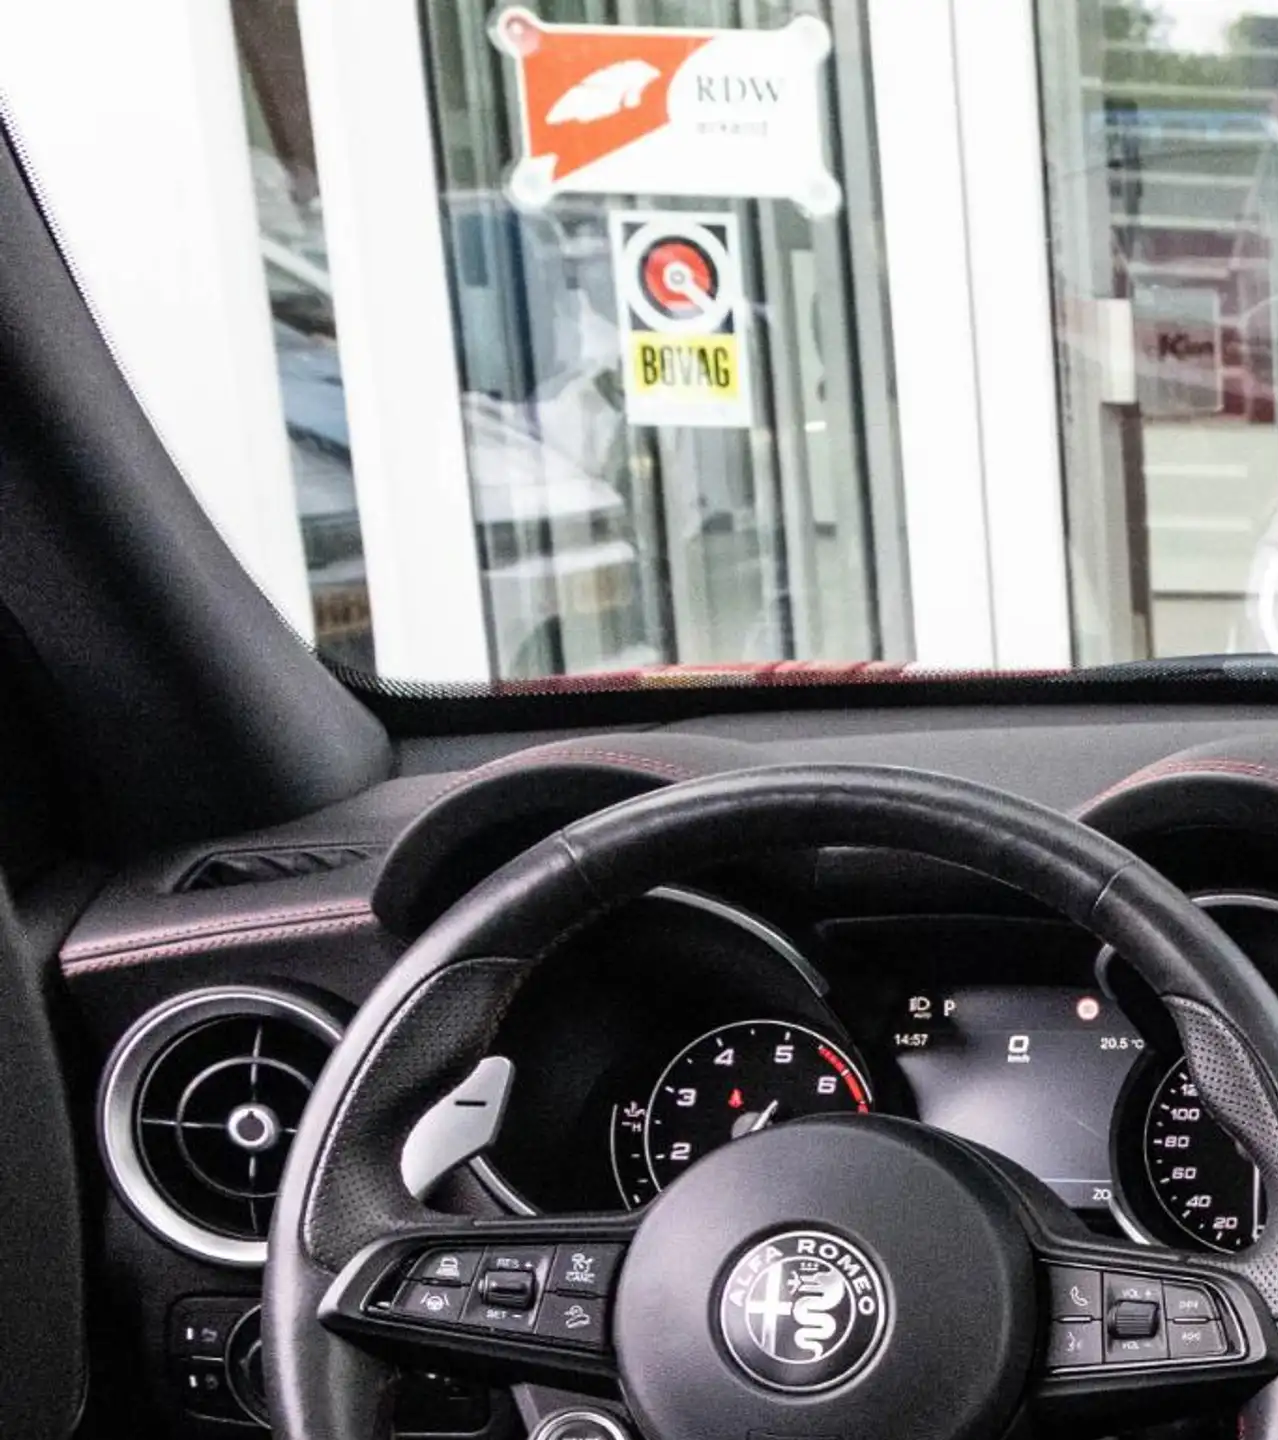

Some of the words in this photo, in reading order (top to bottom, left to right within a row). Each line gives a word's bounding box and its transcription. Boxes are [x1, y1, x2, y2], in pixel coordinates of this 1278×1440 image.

[696, 75, 786, 103] RDW
[642, 344, 731, 389] BOVAG
[943, 1000, 956, 1016] P
[894, 1034, 928, 1046] 14:57
[1008, 1036, 1029, 1053] 0
[1100, 1038, 1128, 1050] 20.5
[714, 1048, 734, 1066] 4
[774, 1045, 794, 1063] 5
[817, 1076, 837, 1094] 6
[676, 1088, 697, 1106] 3
[1170, 1108, 1200, 1121] 100
[1164, 1135, 1190, 1148] 80
[670, 1142, 691, 1161] 2
[1172, 1167, 1197, 1180] 60
[1186, 1194, 1211, 1208] 40
[1212, 1216, 1238, 1230] 20
[728, 1245, 784, 1307] ALFA
[797, 1238, 876, 1316] ROMEO
